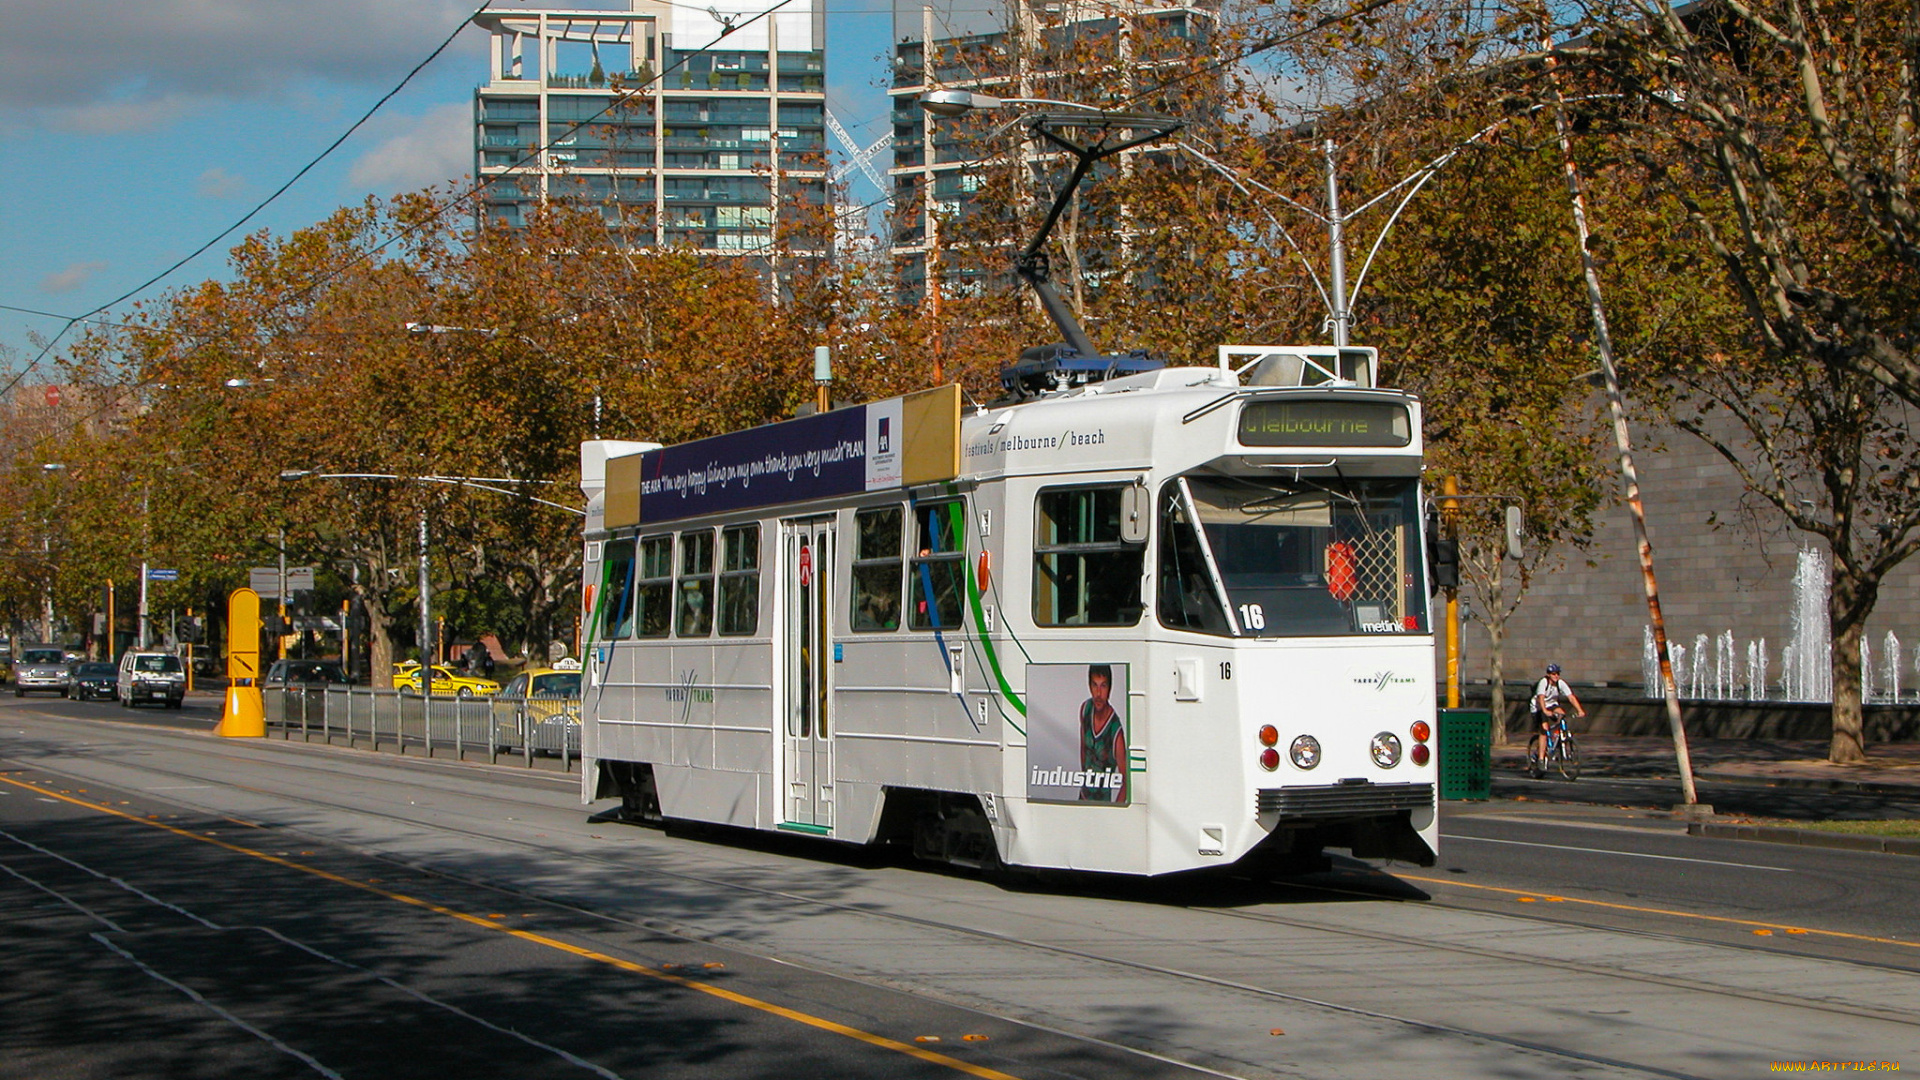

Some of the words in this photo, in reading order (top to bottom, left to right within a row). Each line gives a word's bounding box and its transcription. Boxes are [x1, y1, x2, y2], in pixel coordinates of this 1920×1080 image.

[965, 440, 994, 457] festivals
[1000, 436, 1056, 452] melbourne
[1071, 429, 1105, 446] beach
[641, 481, 651, 494] THE
[673, 474, 688, 499] very
[688, 468, 707, 495] happy
[707, 460, 727, 488] living
[727, 466, 736, 480] on
[736, 462, 750, 488] my
[750, 461, 765, 477] own
[765, 453, 787, 474] thank
[787, 454, 803, 482] you
[803, 450, 821, 478] very
[1239, 604, 1265, 630] 16
[1363, 619, 1406, 633] metlink
[1219, 662, 1232, 680] 16
[1390, 676, 1416, 684] TRAMS
[1031, 765, 1123, 788] industrie
